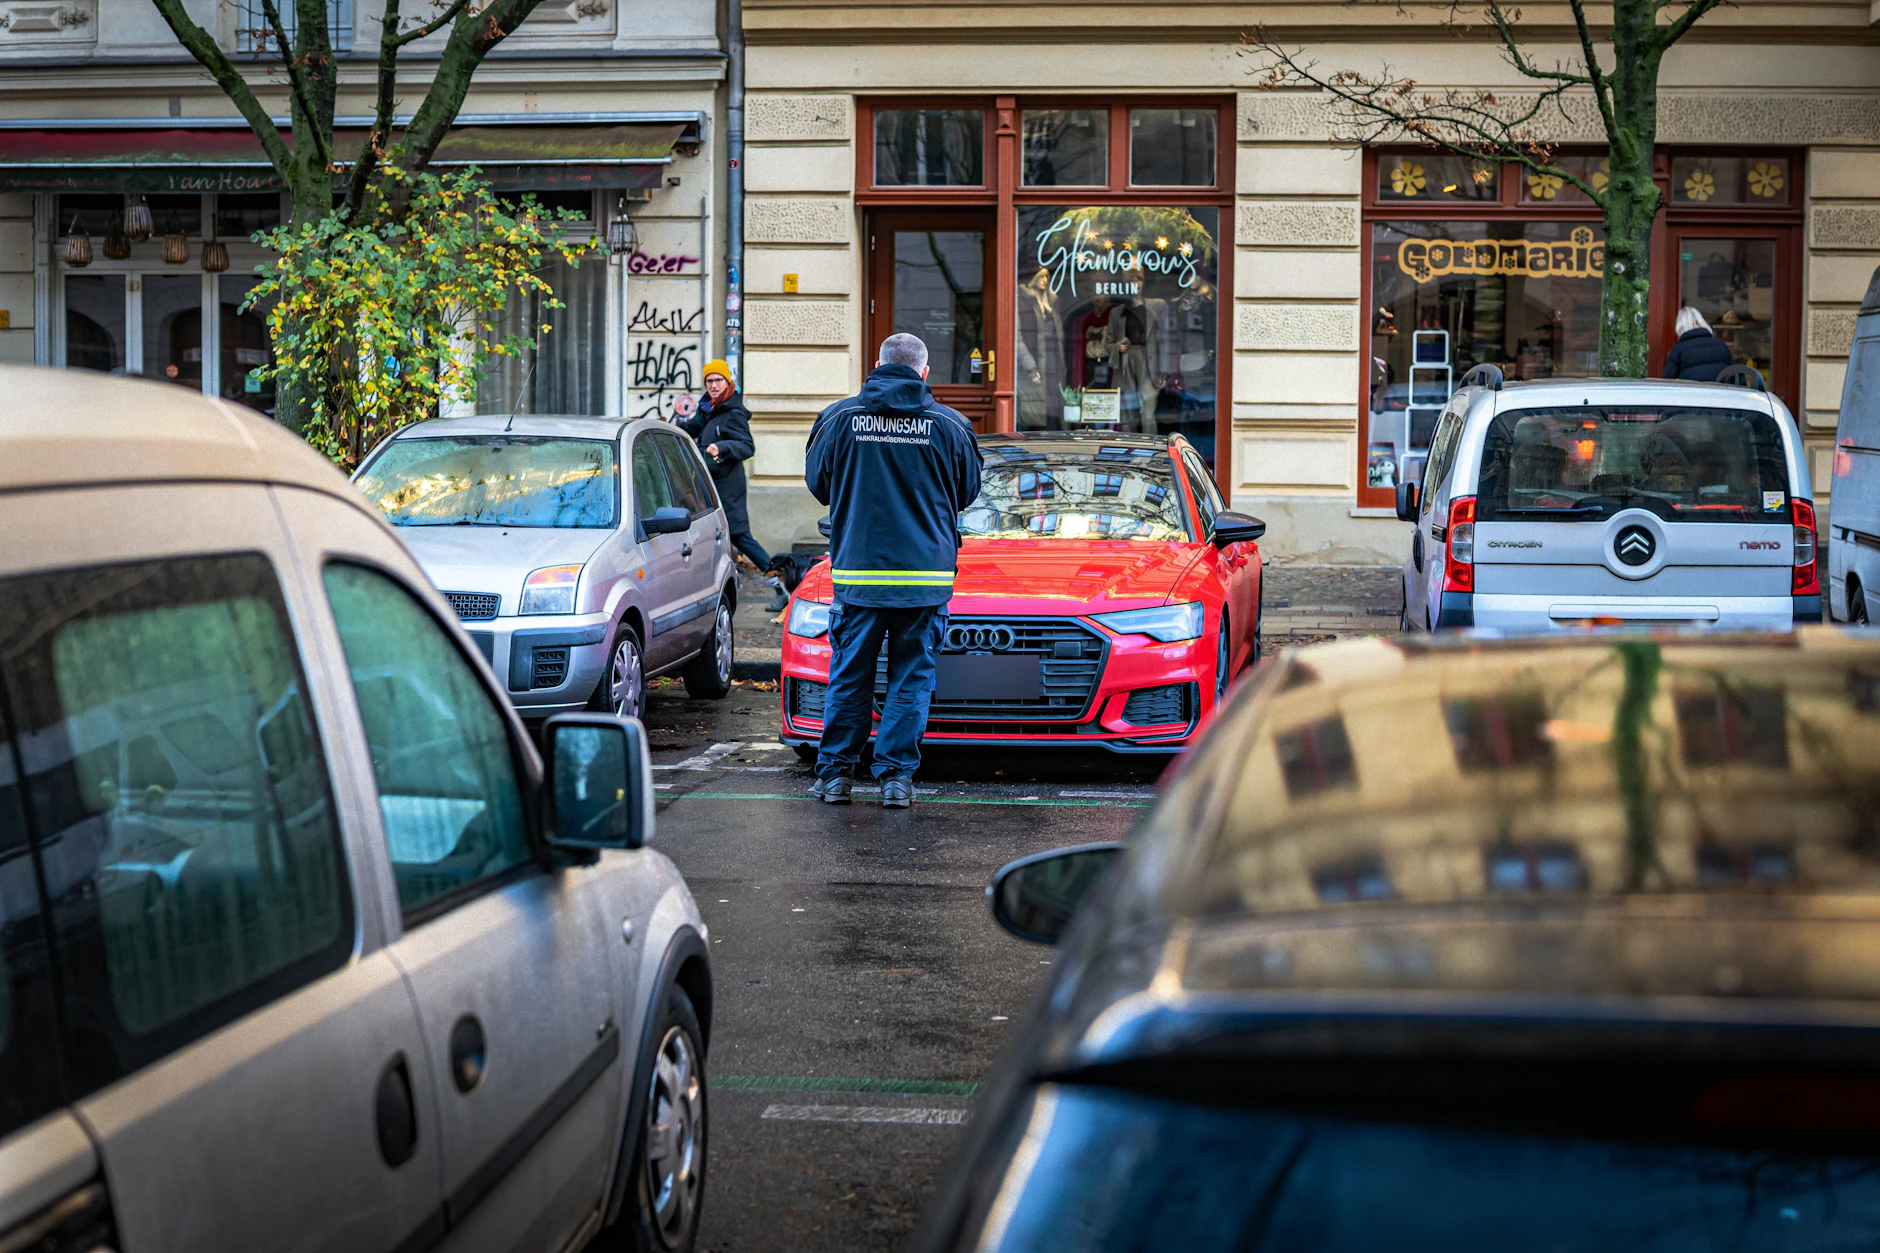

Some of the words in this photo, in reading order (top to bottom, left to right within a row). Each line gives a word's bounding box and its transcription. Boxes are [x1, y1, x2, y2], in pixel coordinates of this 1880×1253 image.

[628, 252, 699, 274] Geier
[1036, 217, 1200, 298] Glamorous
[1095, 282, 1139, 295] BERLIN
[726, 318, 740, 328] ATB
[852, 415, 933, 436] ORDNUNGSAMT
[855, 434, 930, 445] PARKRAUMÜBERWACHUNG
[1739, 540, 1781, 550] nemo
